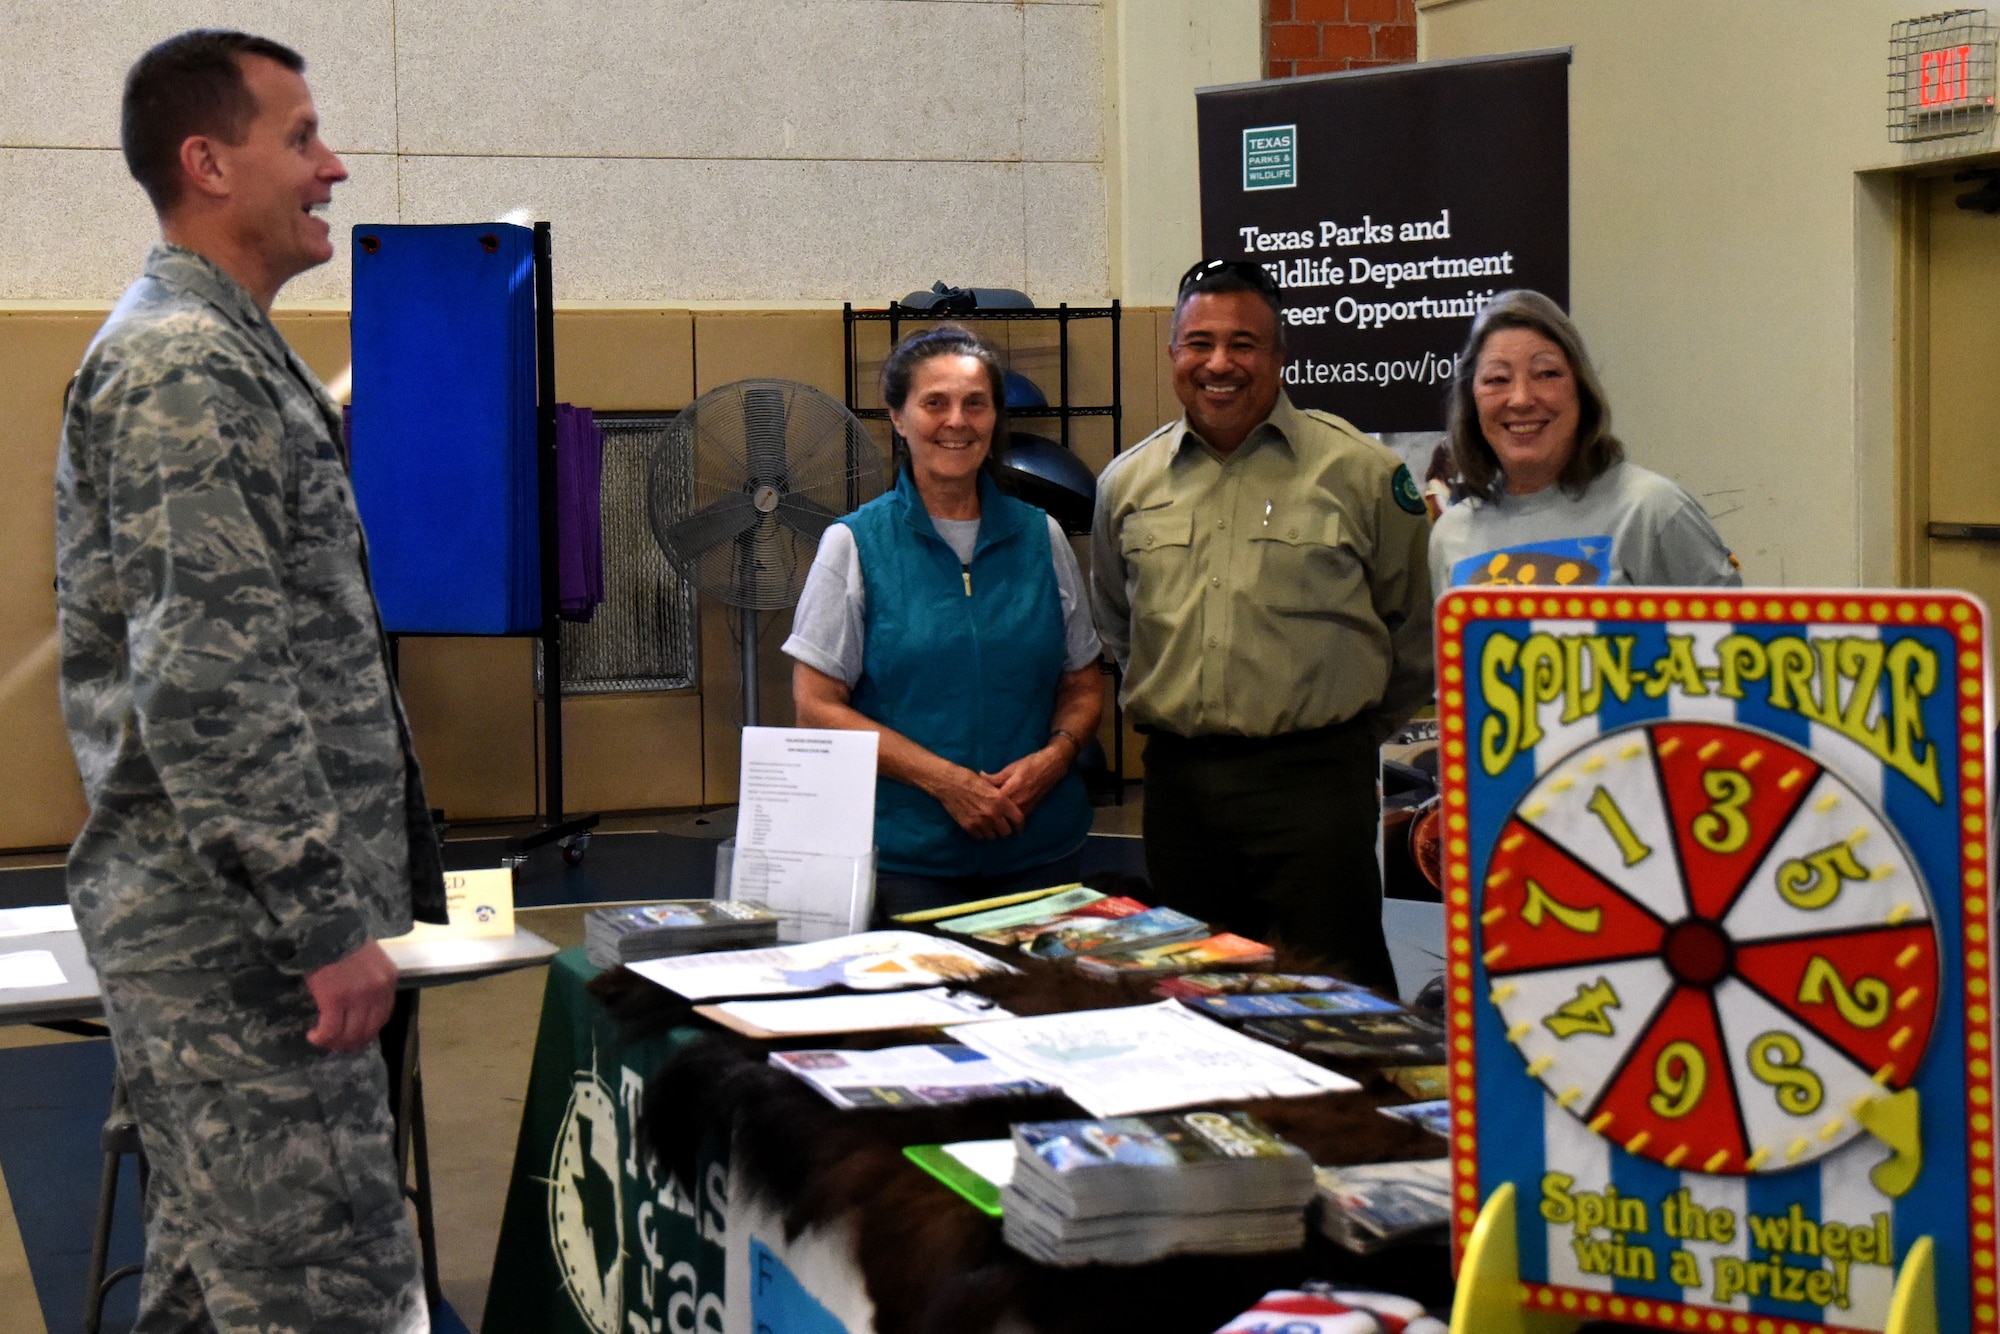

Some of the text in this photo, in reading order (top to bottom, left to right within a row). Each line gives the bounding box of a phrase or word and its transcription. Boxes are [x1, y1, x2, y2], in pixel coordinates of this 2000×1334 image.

[1920, 45, 1970, 107] EXIT
[1248, 154, 1290, 165] PARKS &
[1249, 136, 1291, 150] TEXAS
[1249, 170, 1291, 180] WILDLIFE
[1239, 209, 1451, 252] Texas Parks and
[1261, 251, 1514, 289] ildlife Department
[1480, 632, 1943, 805] SPIN-A-PRIZE
[1587, 786, 1651, 868] 1
[1692, 769, 1753, 854] 3
[1520, 879, 1601, 932] 7
[1776, 842, 1870, 910] 5
[1543, 977, 1620, 1039] 4
[1800, 955, 1891, 1029] 2
[1747, 1031, 1823, 1115] 8
[1540, 1172, 1894, 1266] Spin the wheel
[1572, 1234, 1851, 1310] win a prize!
